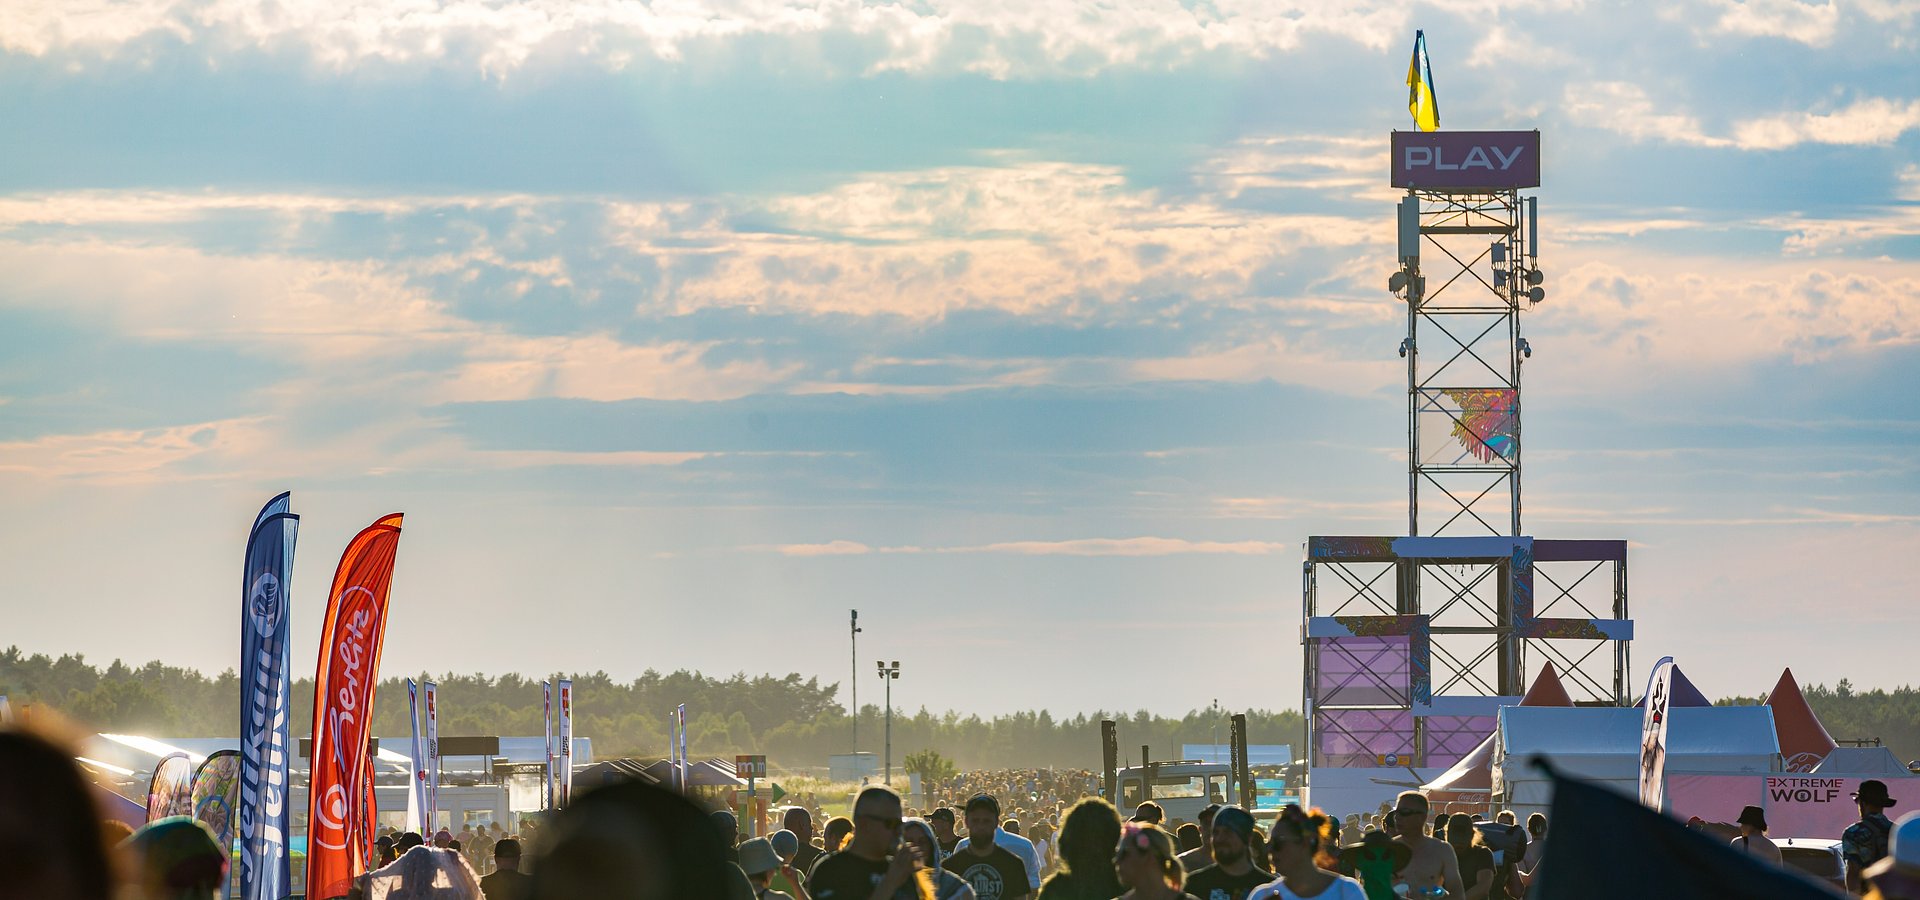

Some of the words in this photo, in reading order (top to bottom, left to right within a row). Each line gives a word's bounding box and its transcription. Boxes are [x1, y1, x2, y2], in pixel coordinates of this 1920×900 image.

[1405, 146, 1524, 170] PLAY
[1766, 777, 1844, 788] EXTREME
[1770, 789, 1840, 803] WOLF
